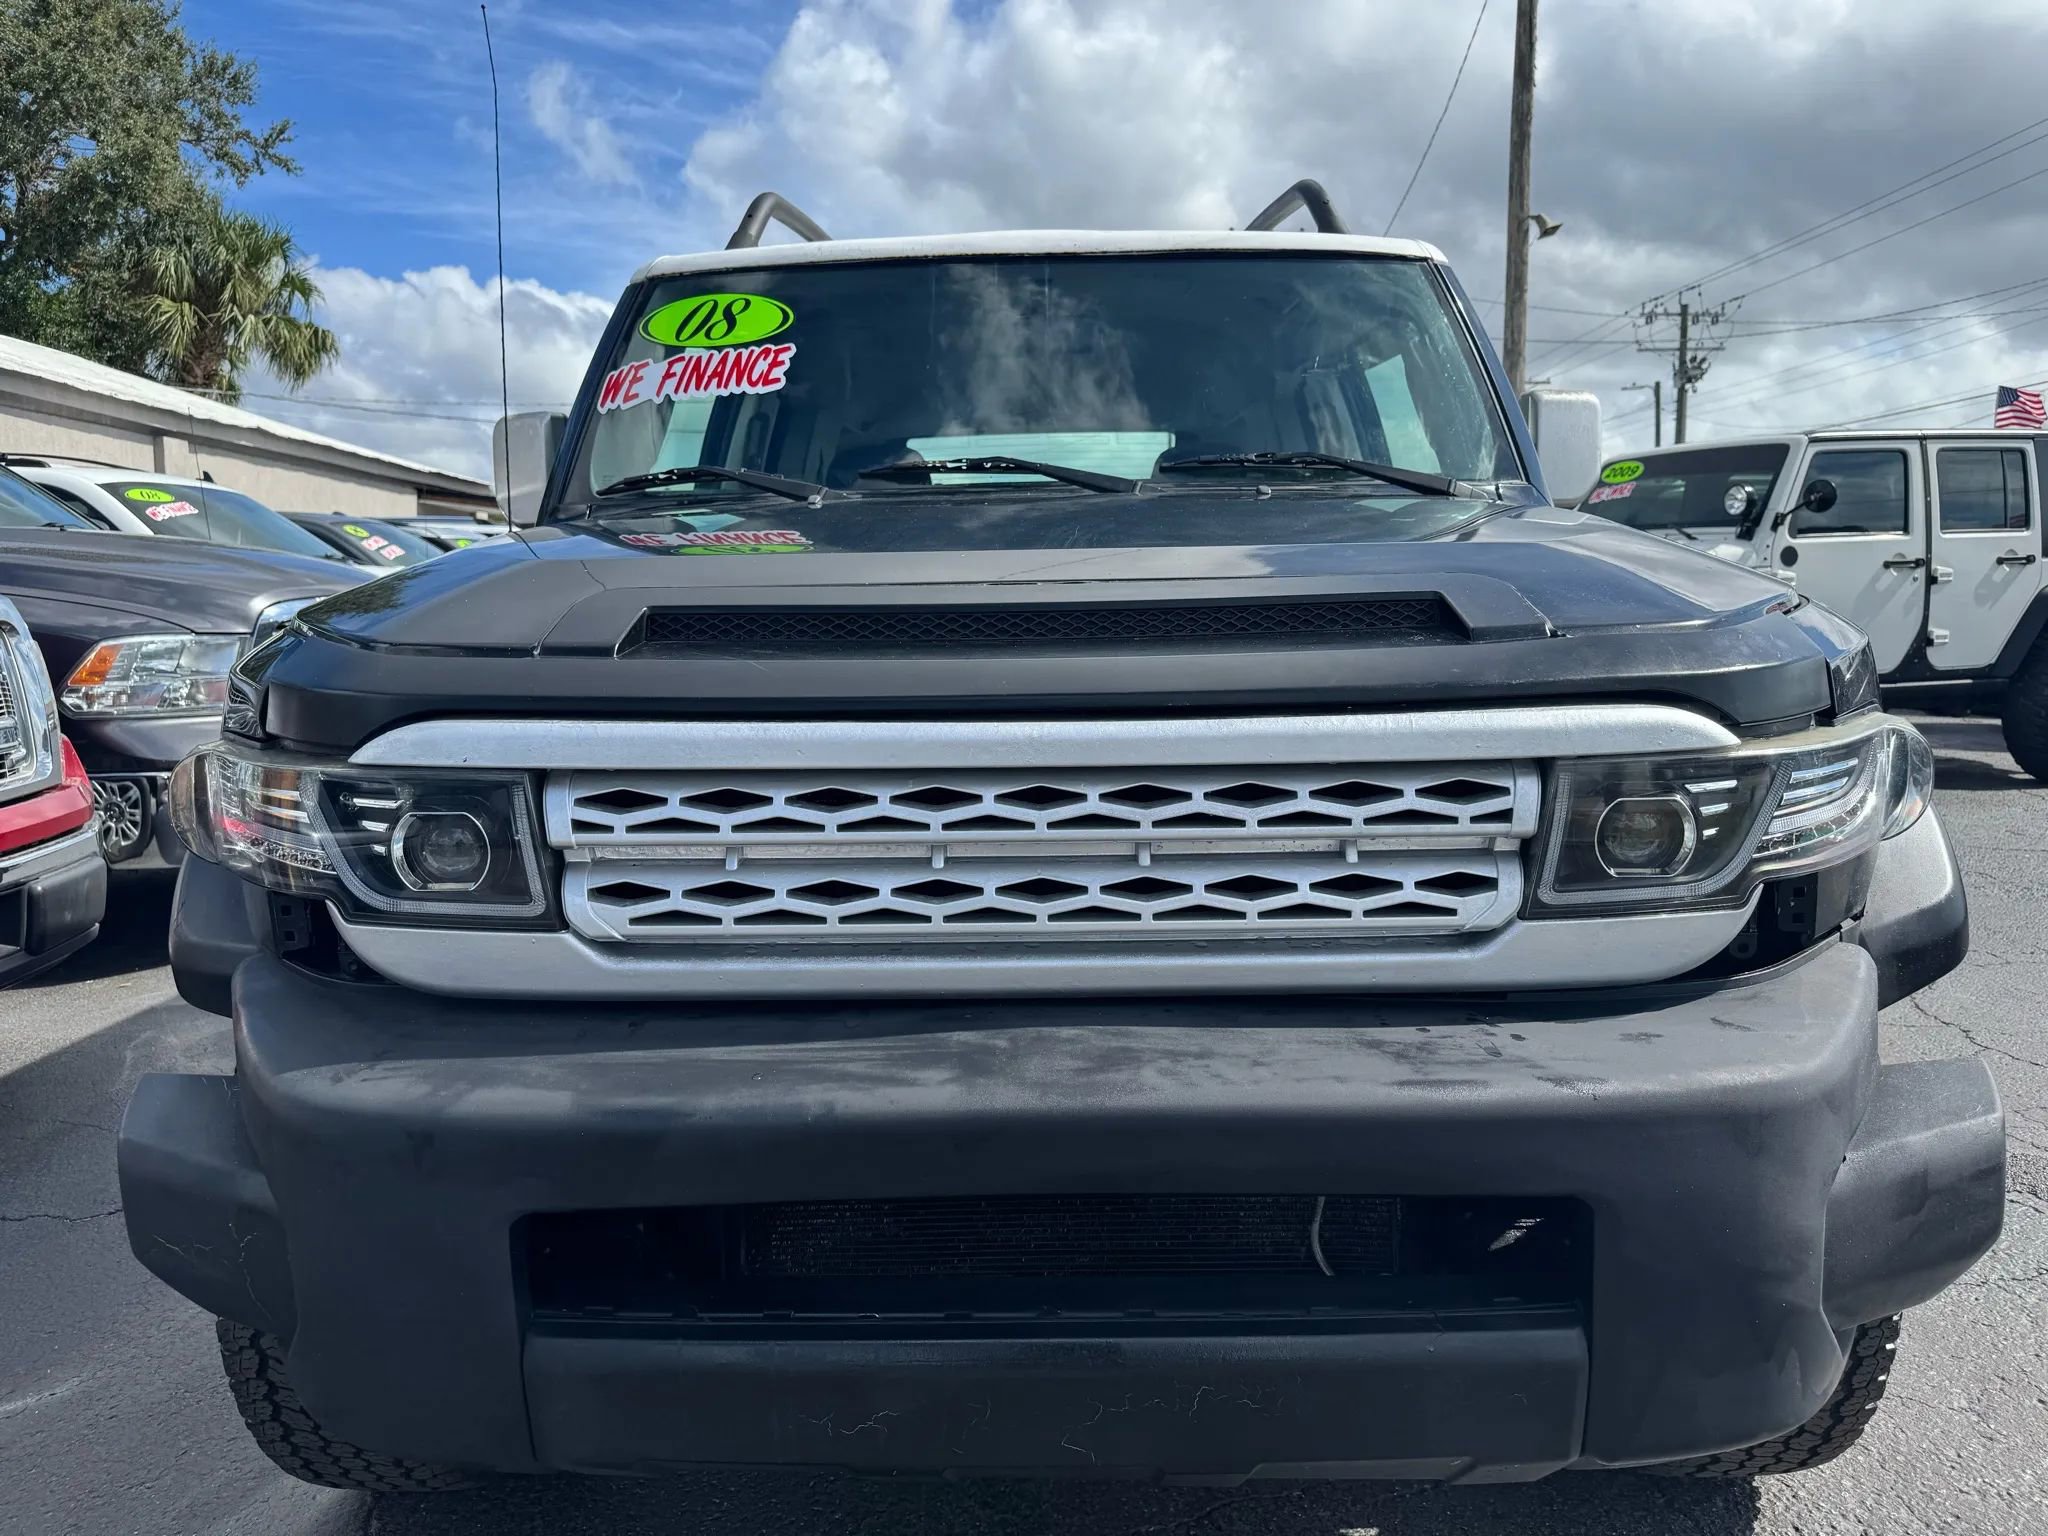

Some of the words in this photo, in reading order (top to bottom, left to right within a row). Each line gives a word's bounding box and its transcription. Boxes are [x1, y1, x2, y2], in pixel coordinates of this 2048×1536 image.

[674, 297, 752, 342] 08
[600, 361, 650, 409] WE
[655, 345, 792, 399] FINANCE
[1604, 464, 1641, 480] 2009
